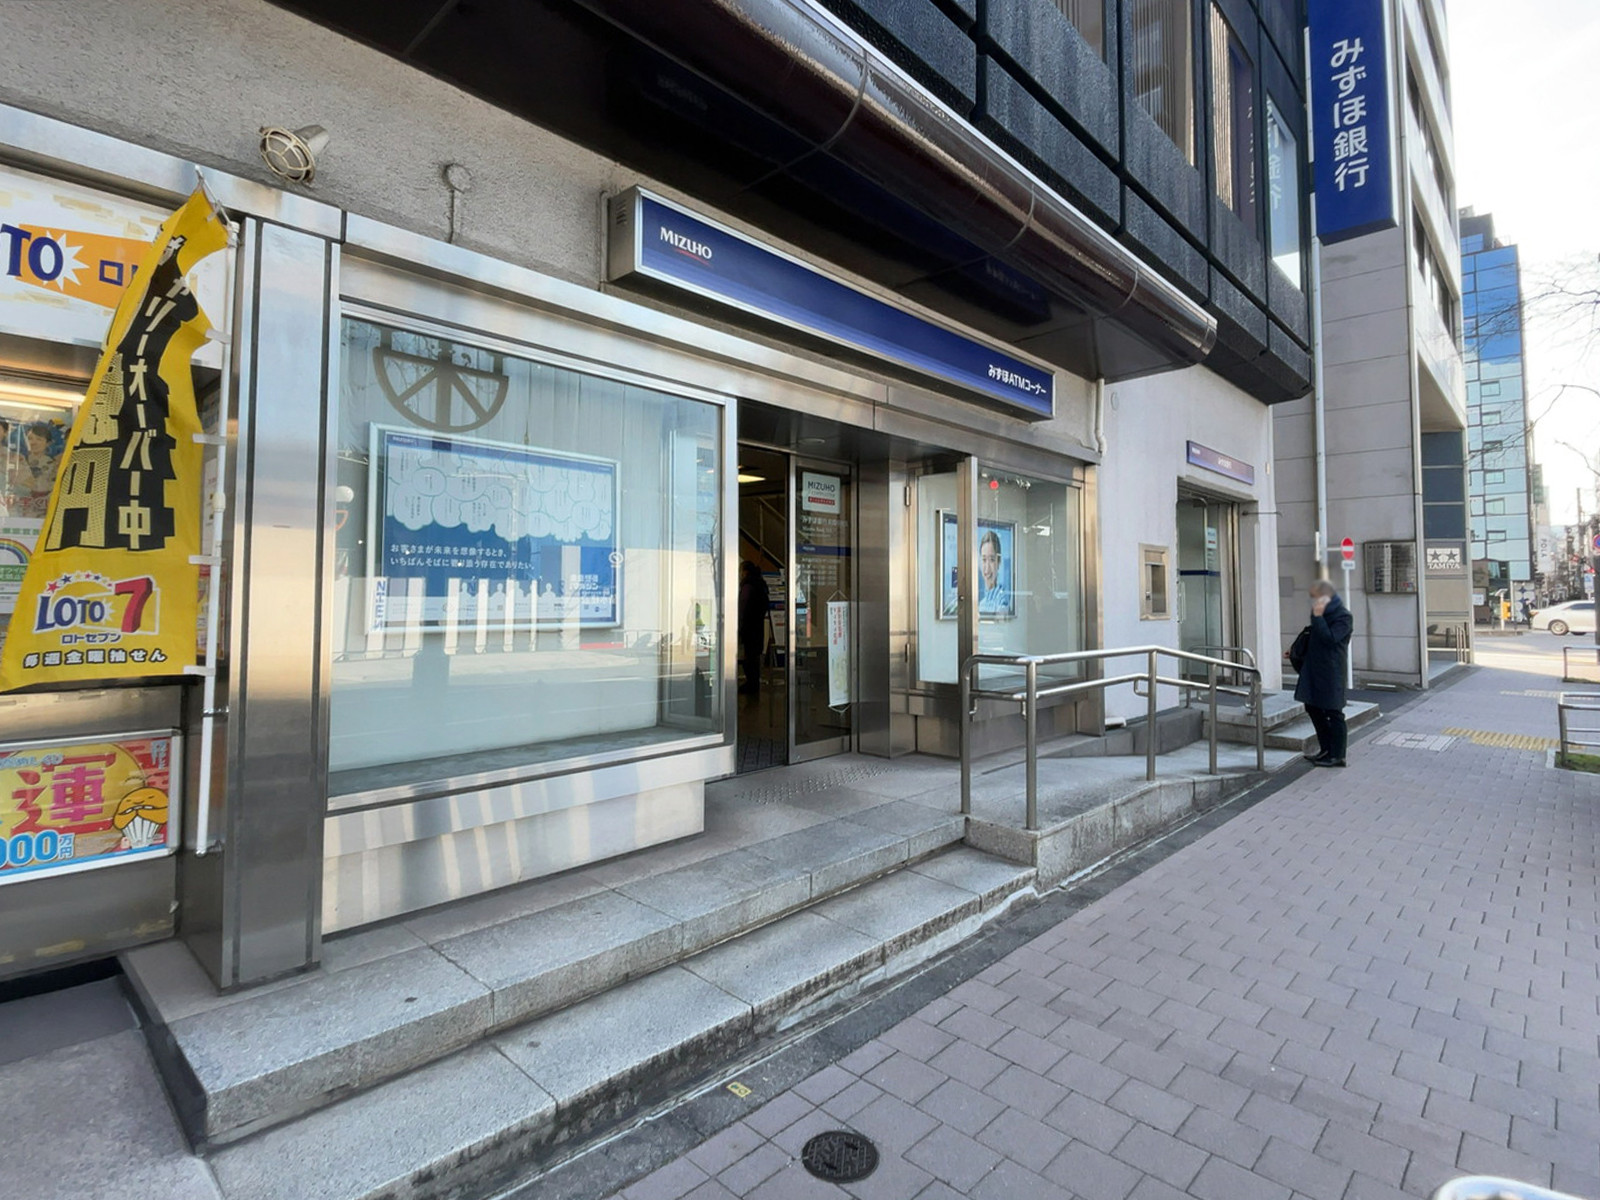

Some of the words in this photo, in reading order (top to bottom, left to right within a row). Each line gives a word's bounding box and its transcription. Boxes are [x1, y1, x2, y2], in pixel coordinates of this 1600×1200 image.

[1330, 37, 1370, 192] みずほ銀行
[660, 226, 713, 260] MIZUHO
[987, 364, 1048, 395] みずほATMコーナー
[807, 480, 836, 493] MIZUHO
[1426, 562, 1461, 570] TAMIYA
[35, 595, 105, 632] LOTO
[114, 577, 154, 633] 7
[61, 632, 122, 645] ロトセブン
[23, 649, 168, 669] 毎週金曜抽せん
